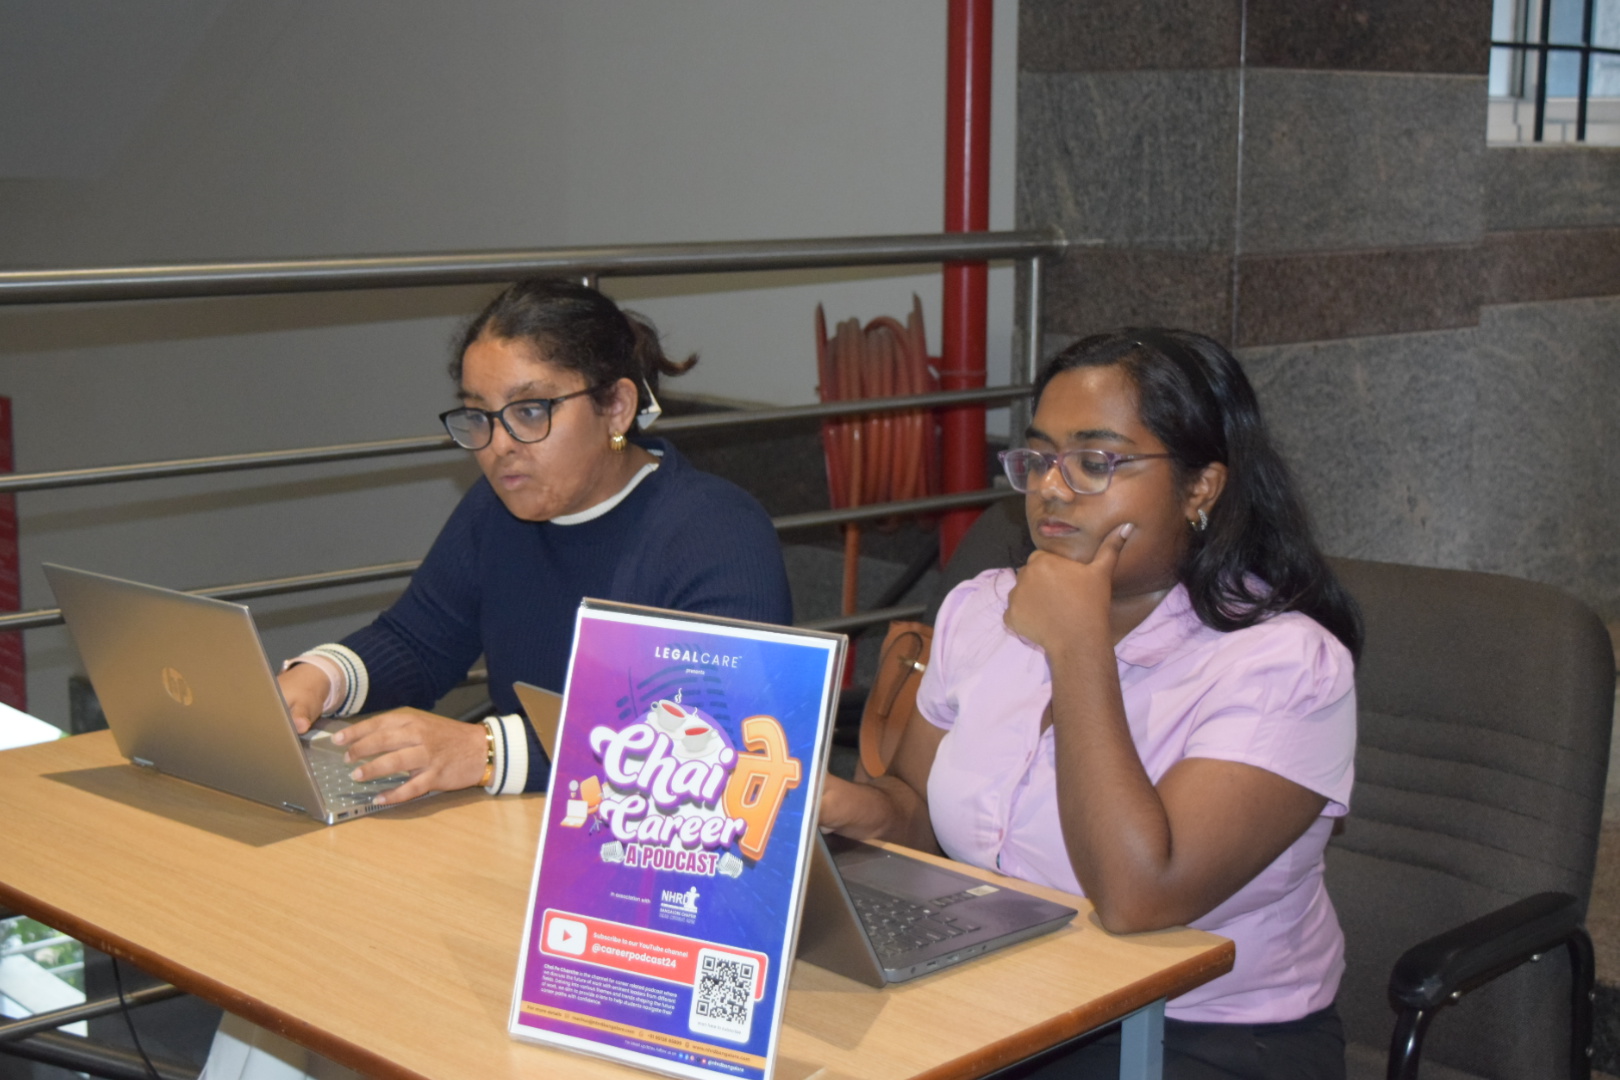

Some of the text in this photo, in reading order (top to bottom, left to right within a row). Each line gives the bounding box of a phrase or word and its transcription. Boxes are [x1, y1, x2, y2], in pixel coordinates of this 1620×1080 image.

[589, 724, 736, 805] Chai
[600, 794, 746, 845] Career
[626, 845, 718, 876] A PODCAST
[592, 943, 676, 968] @careerpodcast24
[594, 932, 621, 943] Subscribe
[639, 942, 664, 952] YouTube
[664, 948, 688, 958] channel
